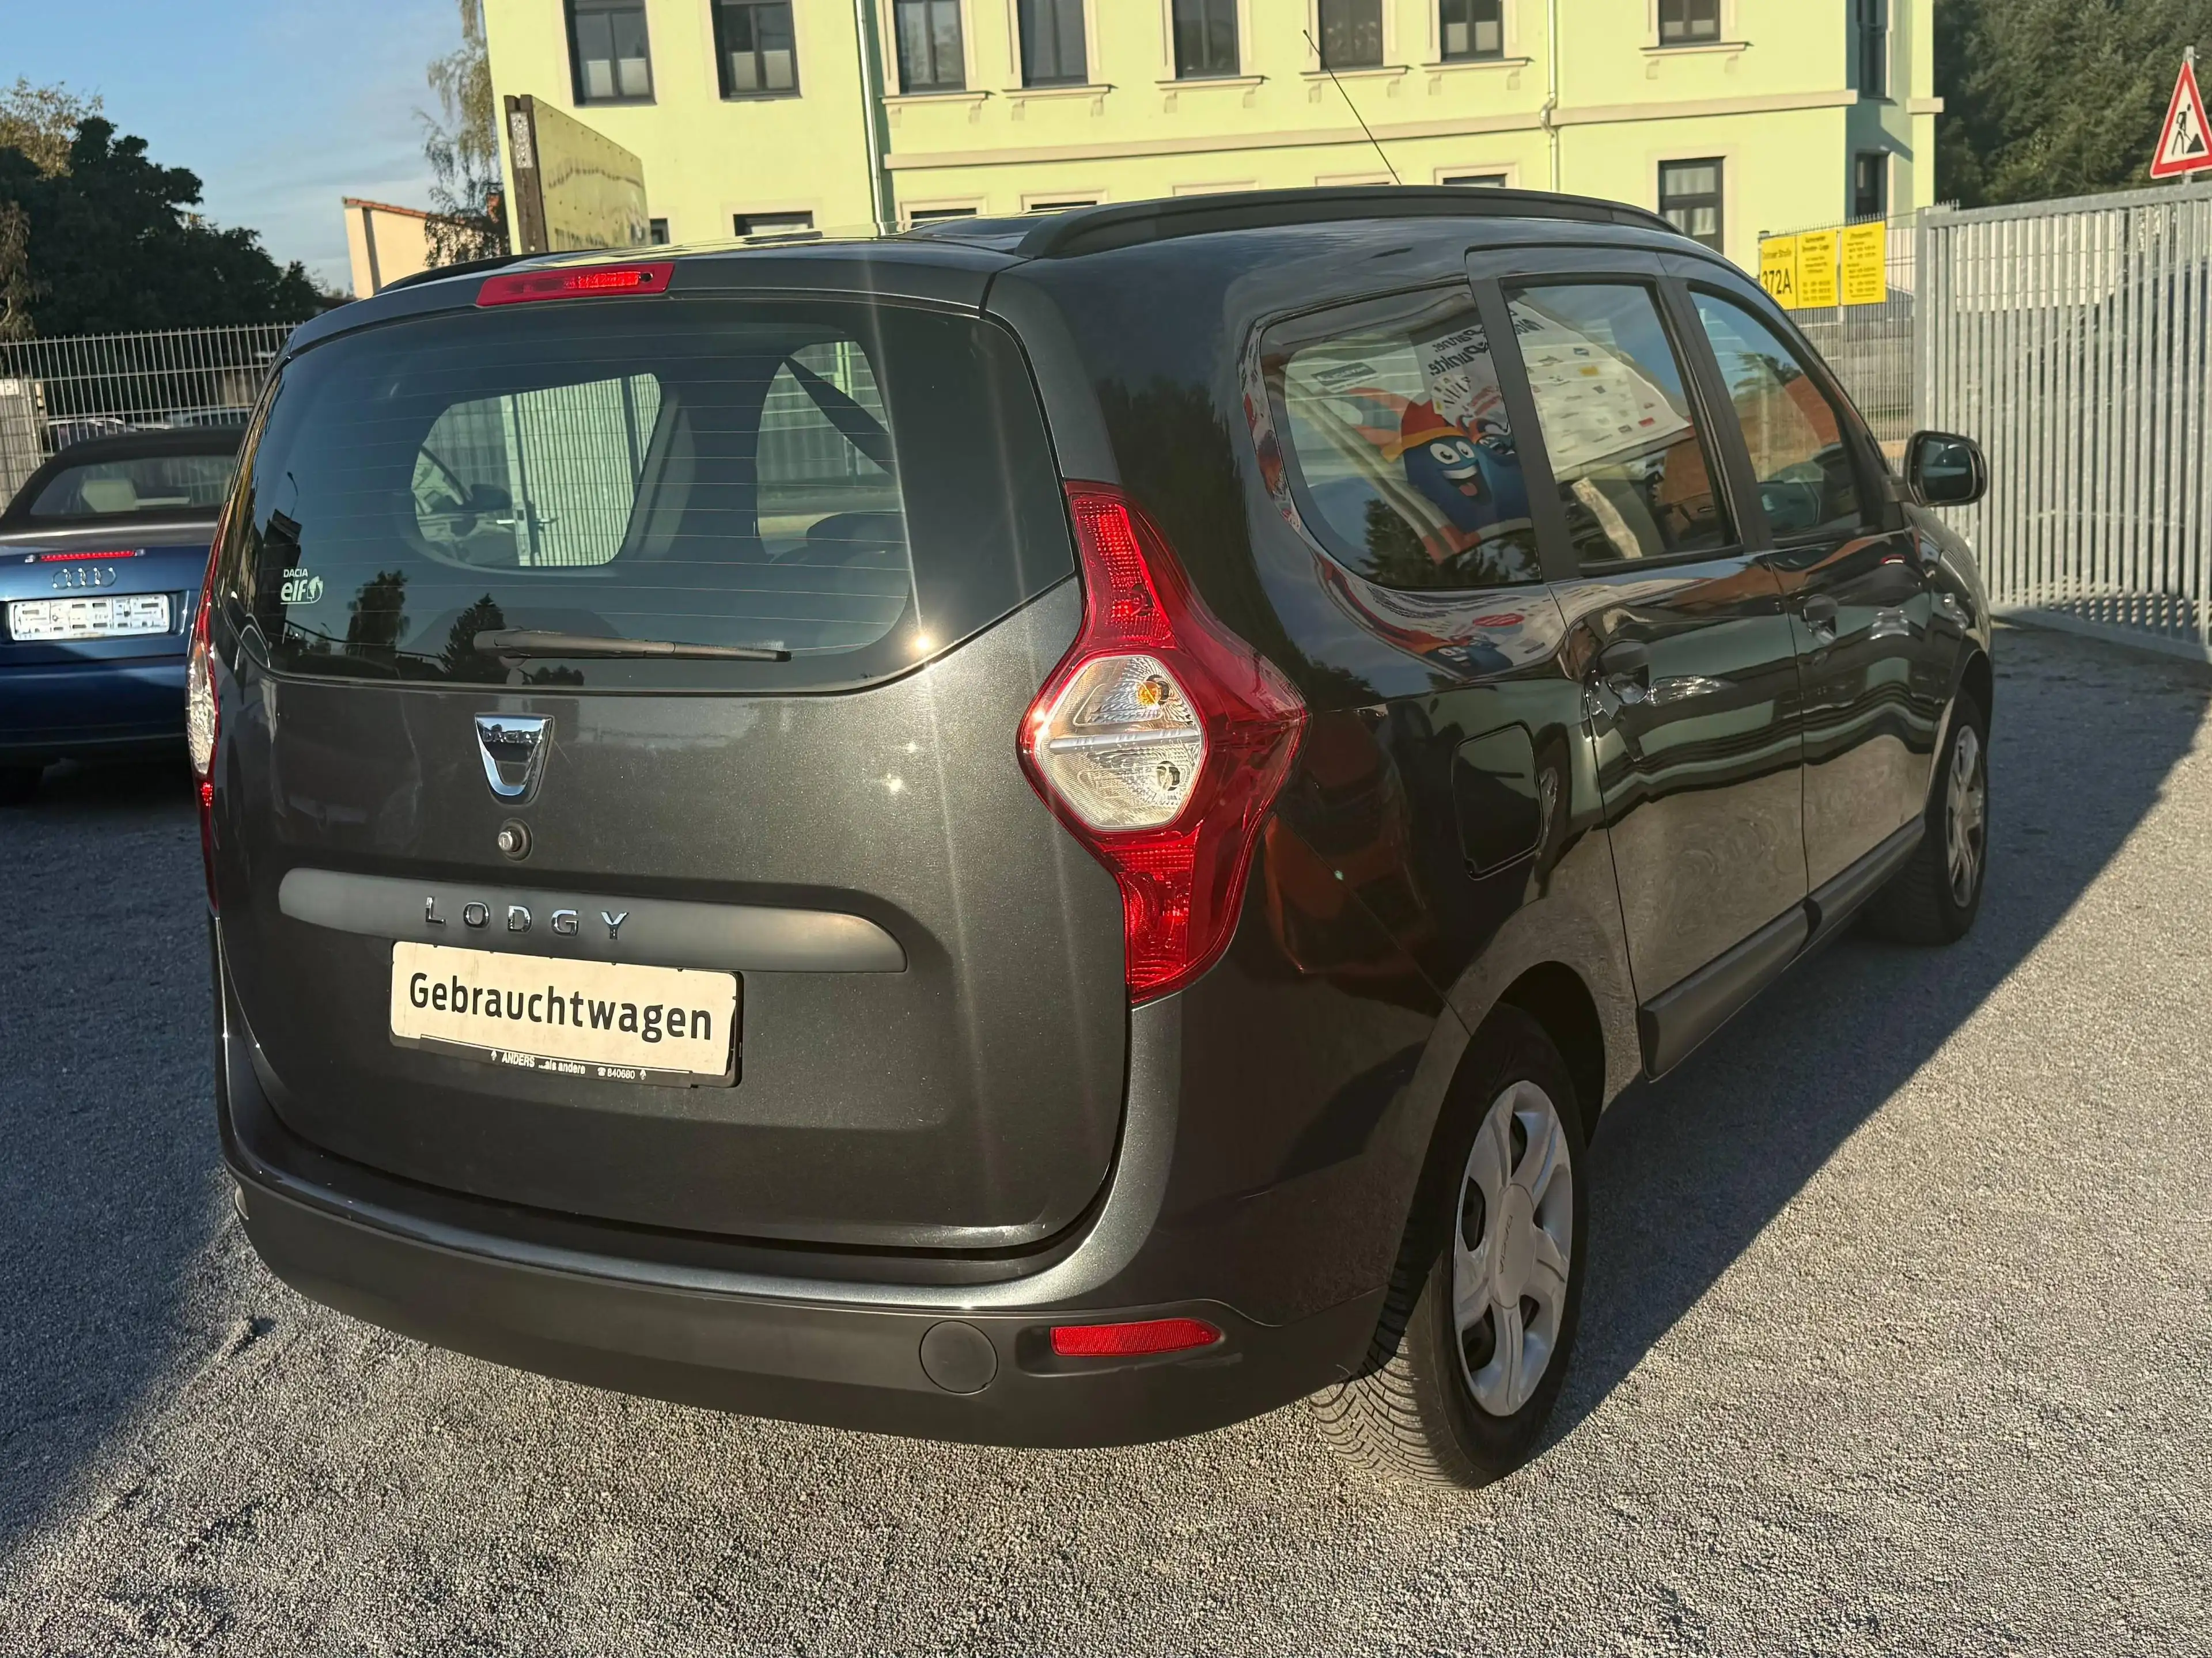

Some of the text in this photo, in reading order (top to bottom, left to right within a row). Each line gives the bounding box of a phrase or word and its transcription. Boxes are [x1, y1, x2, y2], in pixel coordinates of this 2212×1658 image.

[1762, 268, 1792, 294] 372A
[283, 568, 308, 578] DACIA
[281, 579, 308, 601] elf
[483, 730, 534, 743] DACIA
[426, 897, 629, 940] LODGY
[410, 972, 712, 1043] Gebrauchtwagen
[501, 1052, 535, 1068] ANDERS
